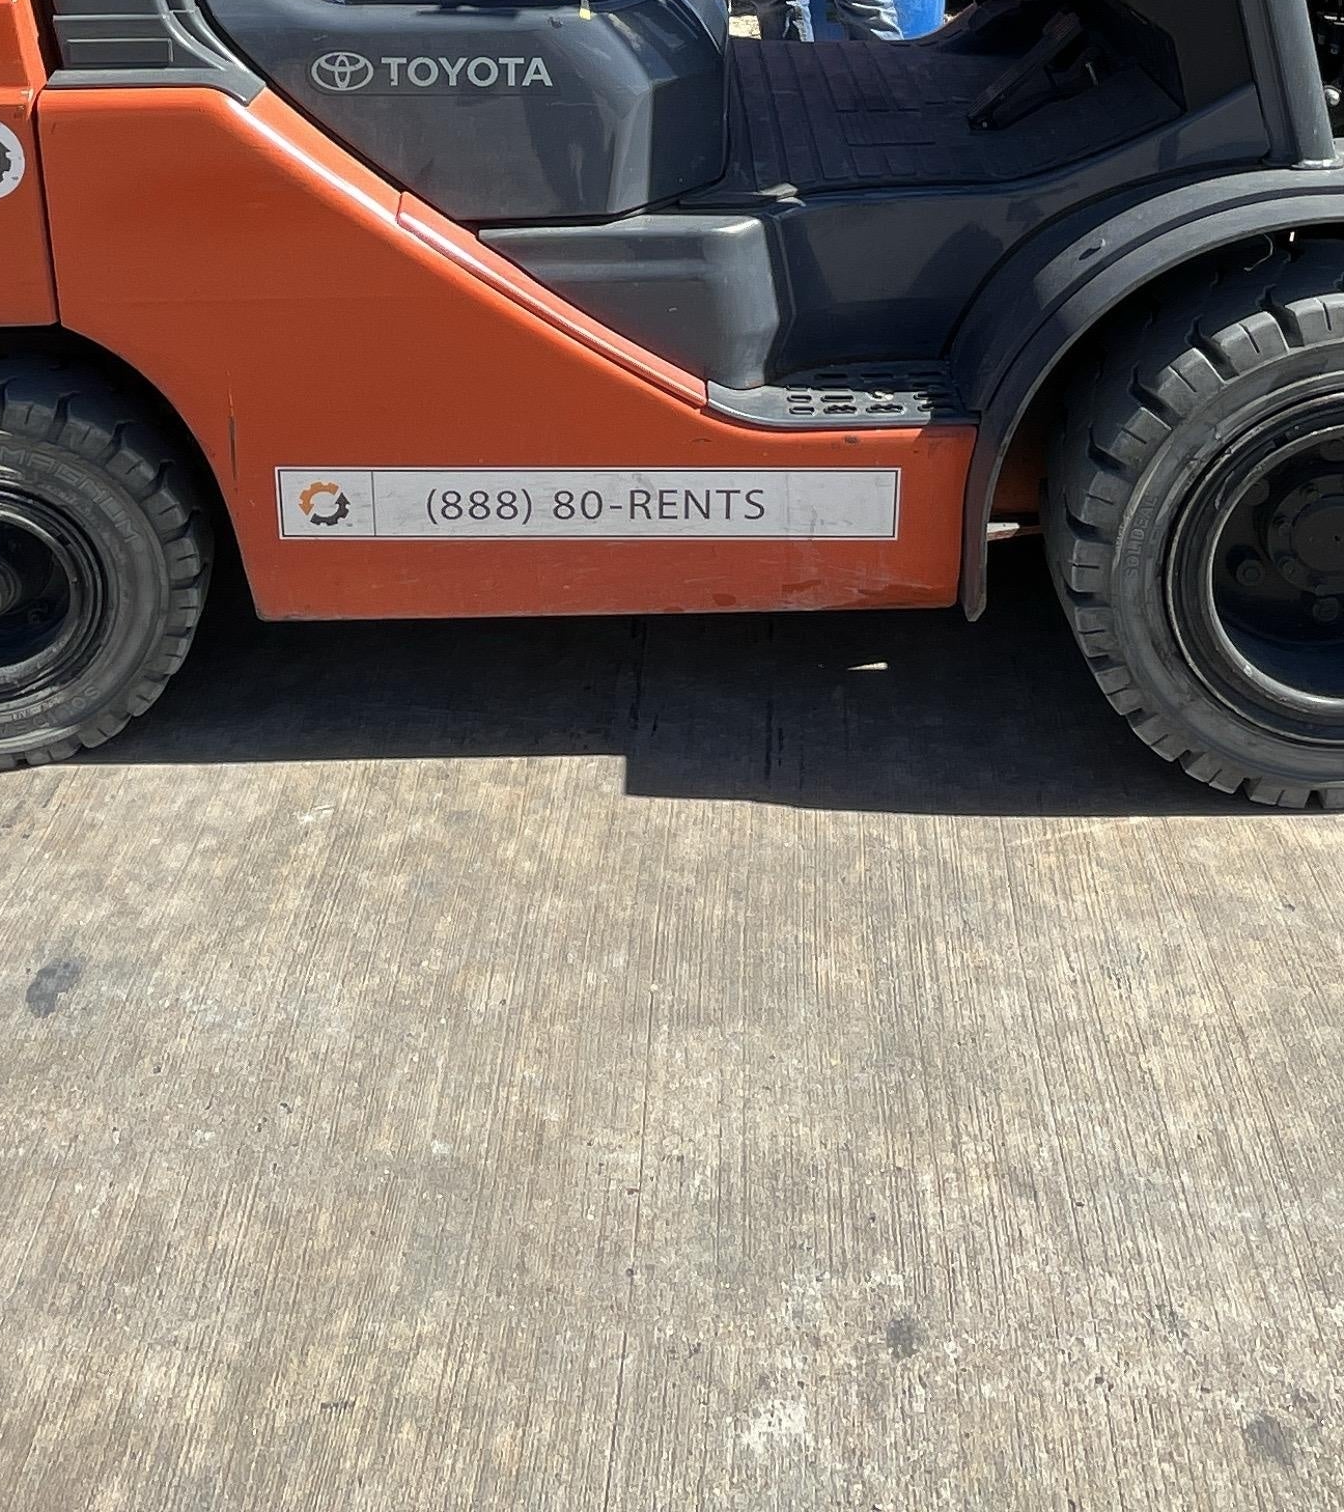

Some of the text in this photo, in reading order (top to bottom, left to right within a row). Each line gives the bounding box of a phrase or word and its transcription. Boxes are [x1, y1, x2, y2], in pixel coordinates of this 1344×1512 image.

[381, 56, 553, 87] TOYOTA
[425, 487, 767, 528] (888) 80-RENTS
